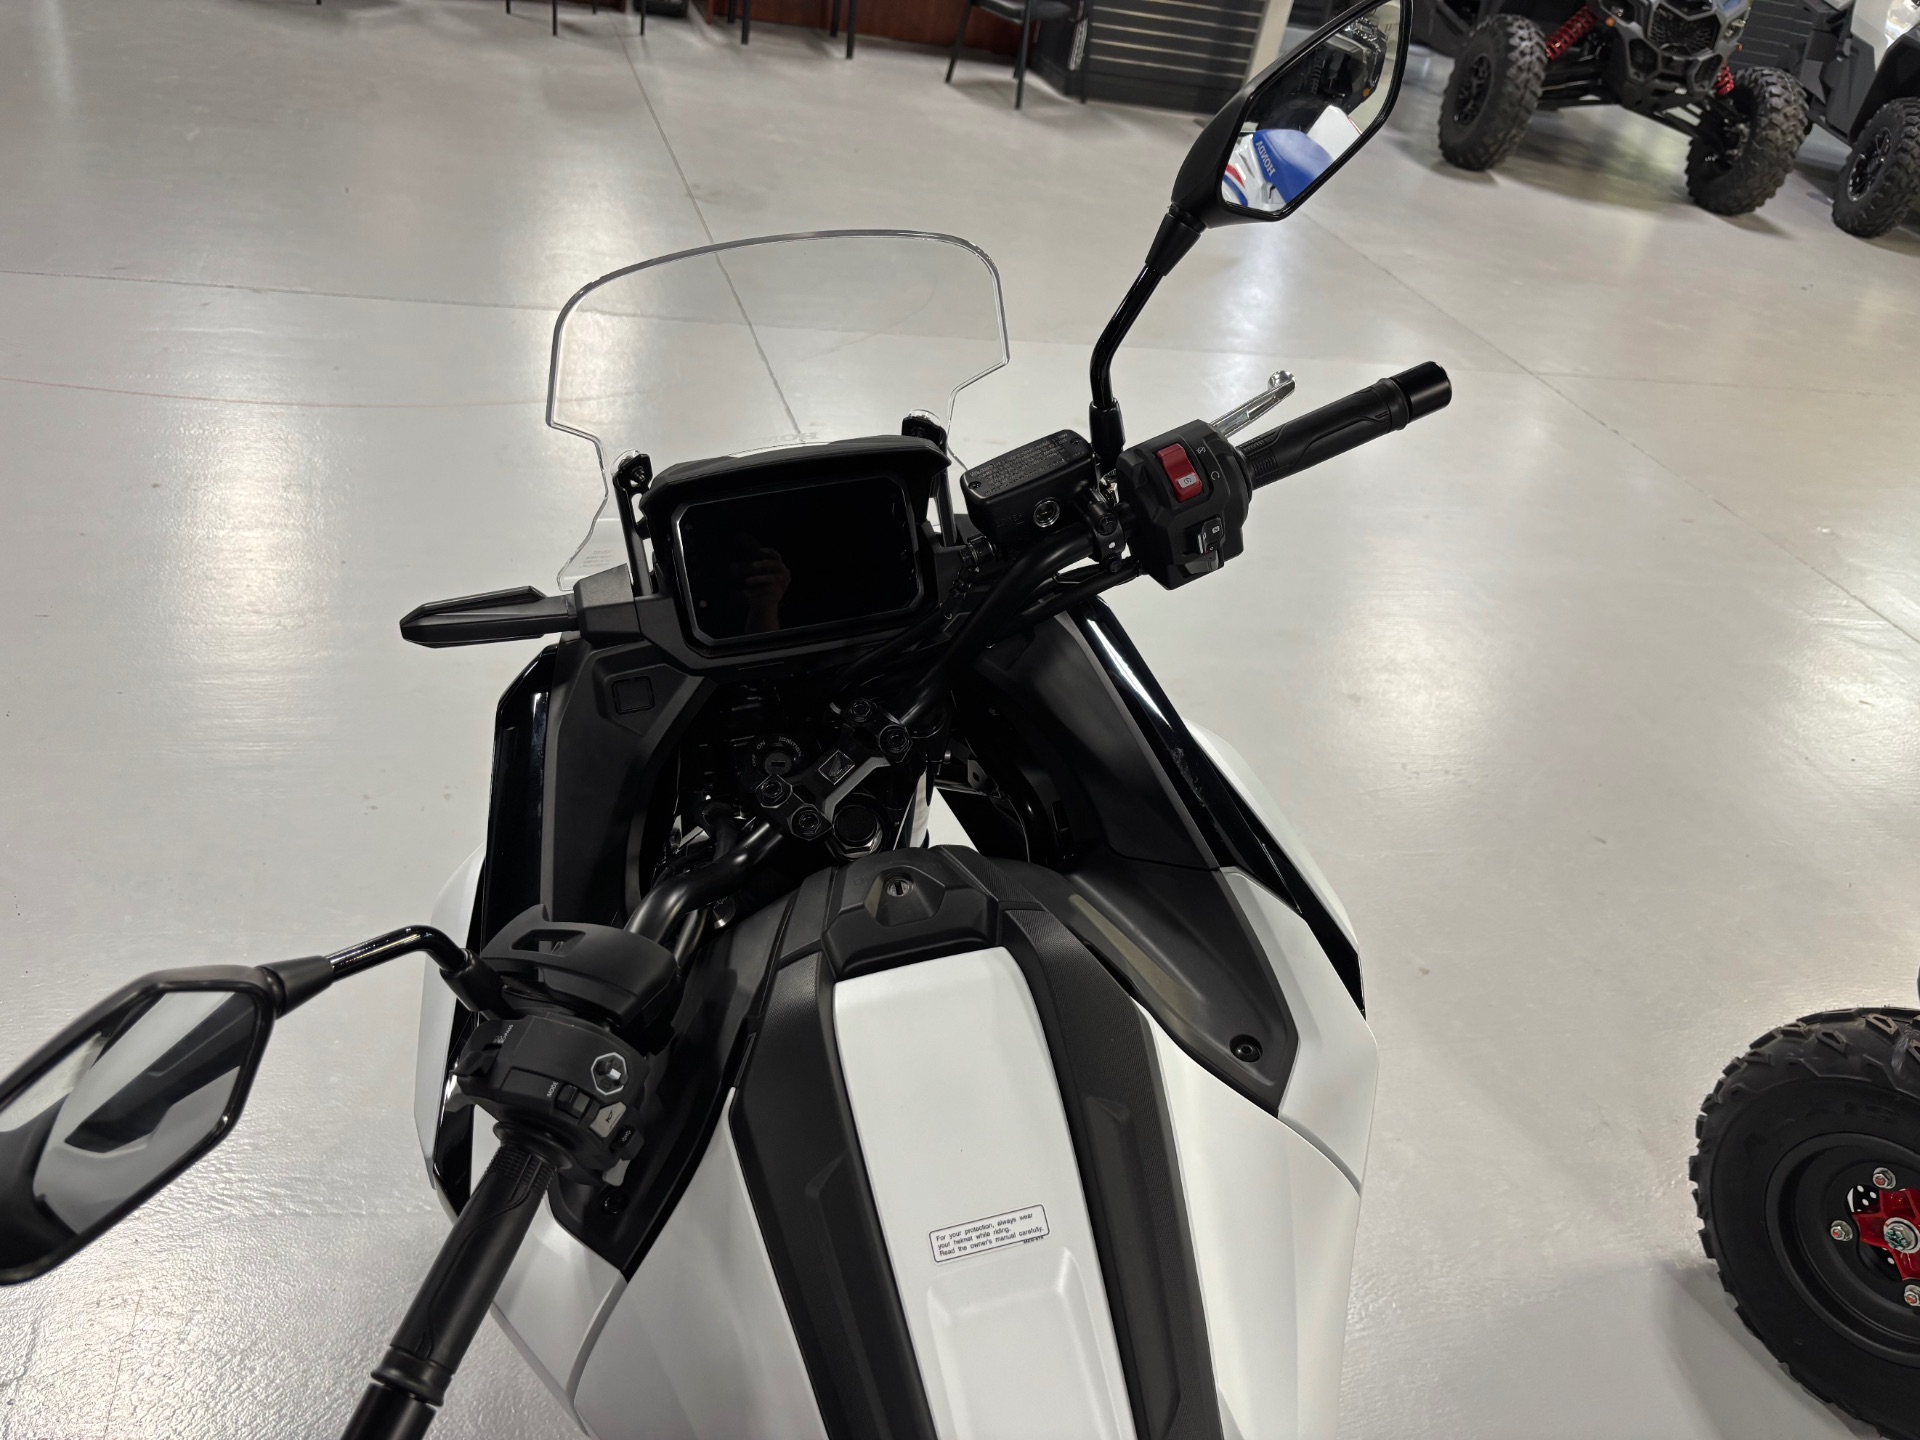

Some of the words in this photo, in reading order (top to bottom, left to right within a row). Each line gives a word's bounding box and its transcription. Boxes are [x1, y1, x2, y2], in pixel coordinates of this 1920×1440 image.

[756, 739, 766, 750] ON
[778, 735, 802, 757] IGNITION
[546, 1080, 559, 1098] MODE
[936, 1234, 946, 1242] For
[949, 1230, 962, 1239] your
[965, 1223, 995, 1236] protection,
[997, 1217, 1017, 1226] always
[1019, 1213, 1033, 1221] wear
[938, 1241, 950, 1250] your
[953, 1236, 974, 1245] helmet
[976, 1231, 991, 1240] while
[993, 1226, 1012, 1236] riding.
[970, 1239, 993, 1249] owner's
[995, 1233, 1017, 1243] manual
[1018, 1226, 1045, 1237] carefully.
